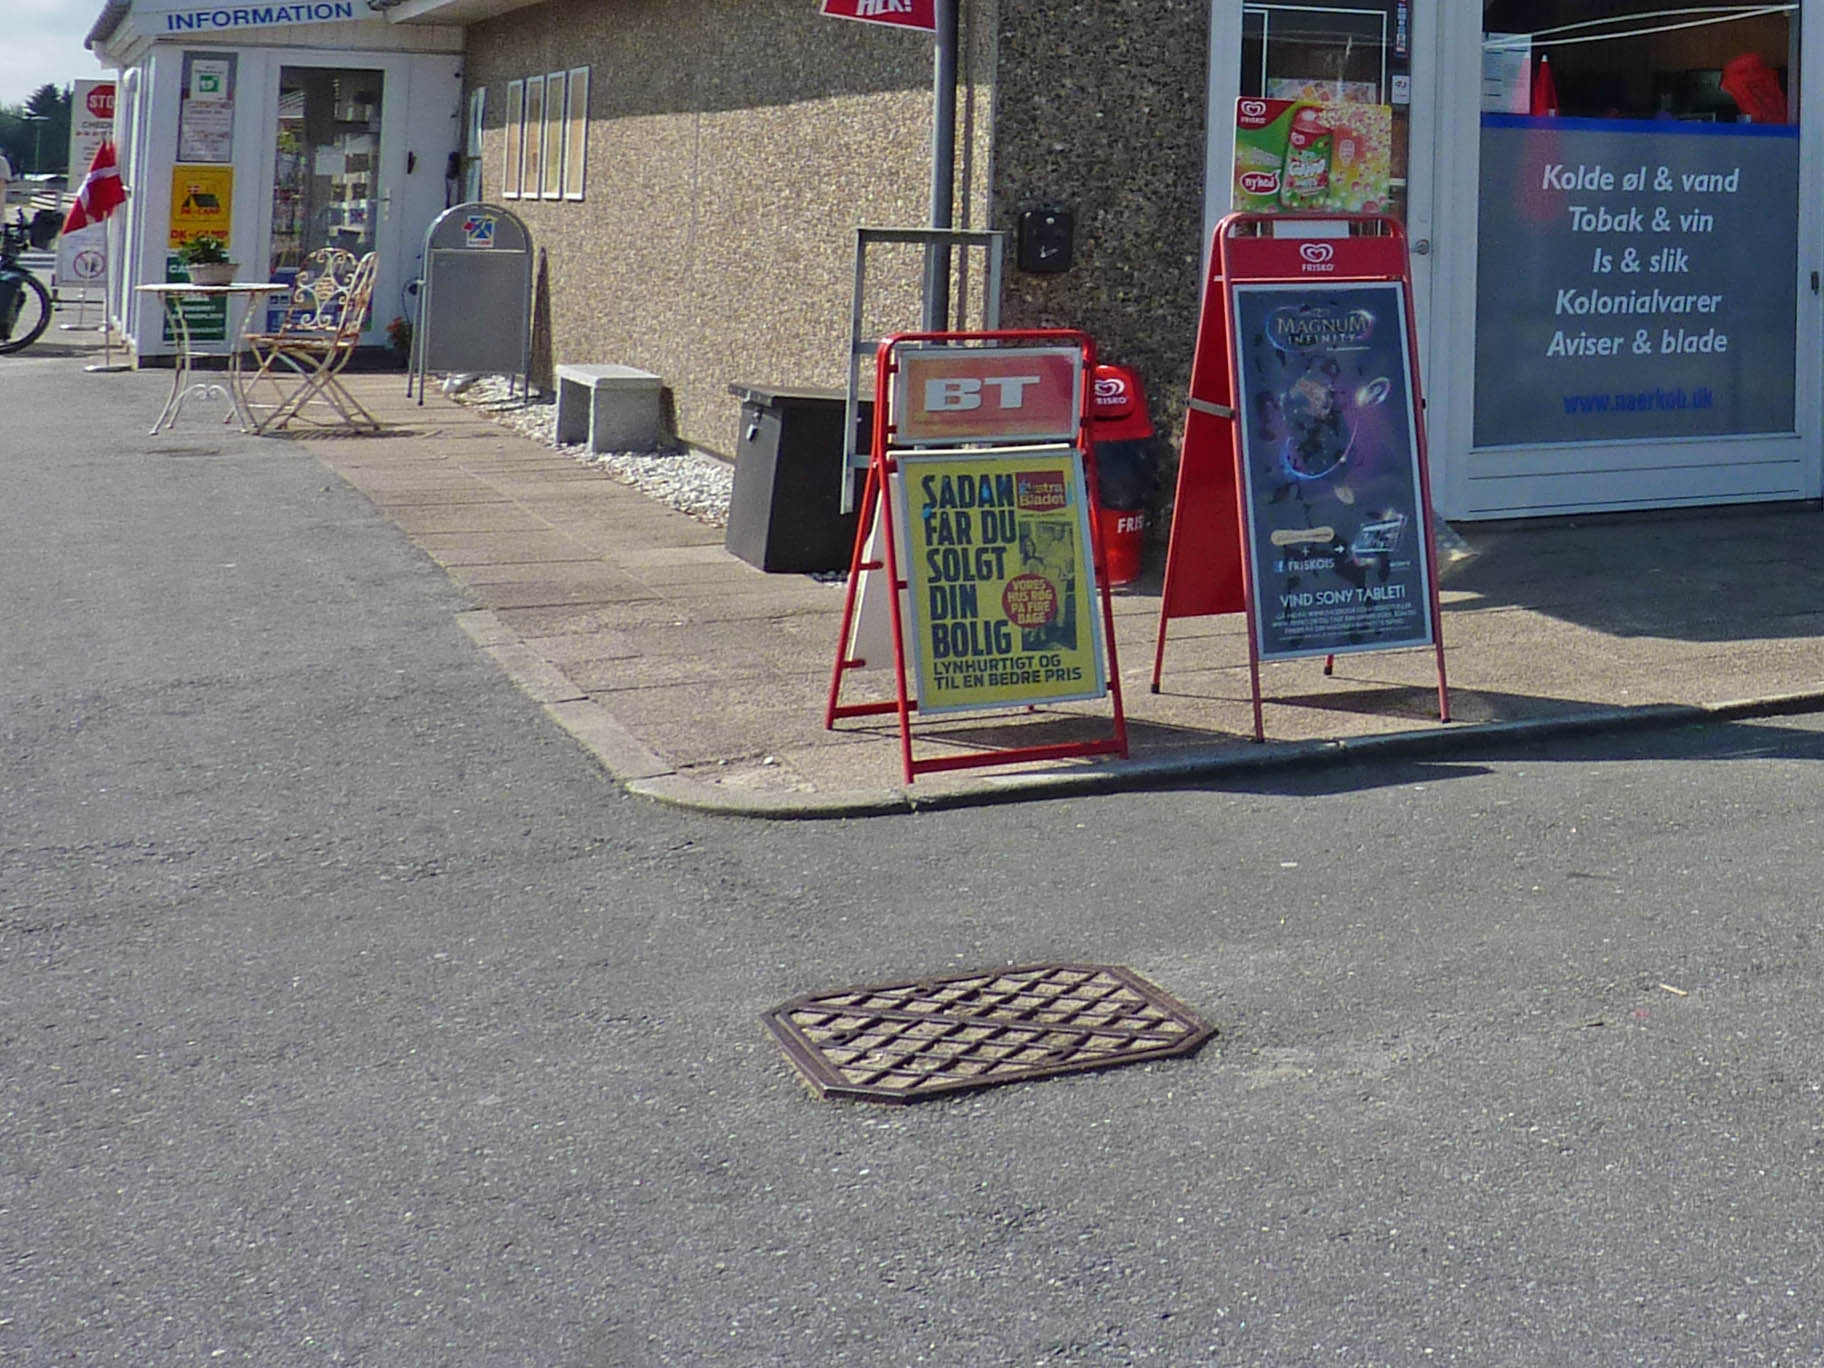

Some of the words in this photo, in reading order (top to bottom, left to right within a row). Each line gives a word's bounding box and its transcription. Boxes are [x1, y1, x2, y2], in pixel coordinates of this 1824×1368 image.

[168, 3, 353, 31] INFORMATION
[1542, 165, 1614, 191] Kolde
[1622, 166, 1647, 191] øl
[1653, 166, 1673, 192] &
[1682, 168, 1740, 192] vand
[1568, 207, 1644, 232] Tobak
[1651, 207, 1671, 232] &
[1680, 209, 1714, 232] vin
[1592, 248, 1613, 273] Is
[1620, 247, 1641, 273] &
[1649, 248, 1689, 273] slik
[1555, 288, 1722, 315] Kolonialvarer
[1276, 315, 1367, 334] MAGNUM
[1287, 333, 1357, 345] INFINITY
[1546, 331, 1625, 357] Aviser
[1632, 330, 1652, 355] &
[1661, 329, 1728, 354] blade
[924, 376, 1041, 412] BT
[981, 509, 1017, 544] DU
[926, 546, 1008, 583] SOLGT
[929, 583, 979, 621] DIN
[1280, 592, 1313, 608] VIND
[1316, 589, 1353, 606] SONY
[931, 620, 1013, 660] BOLIG
[934, 656, 1035, 676] LYNHURTIGT
[1039, 654, 1062, 669] OG
[934, 675, 958, 691] TIL
[963, 674, 985, 689] EN
[988, 670, 1042, 687] BEDRE
[1044, 666, 1083, 682] PRIS
